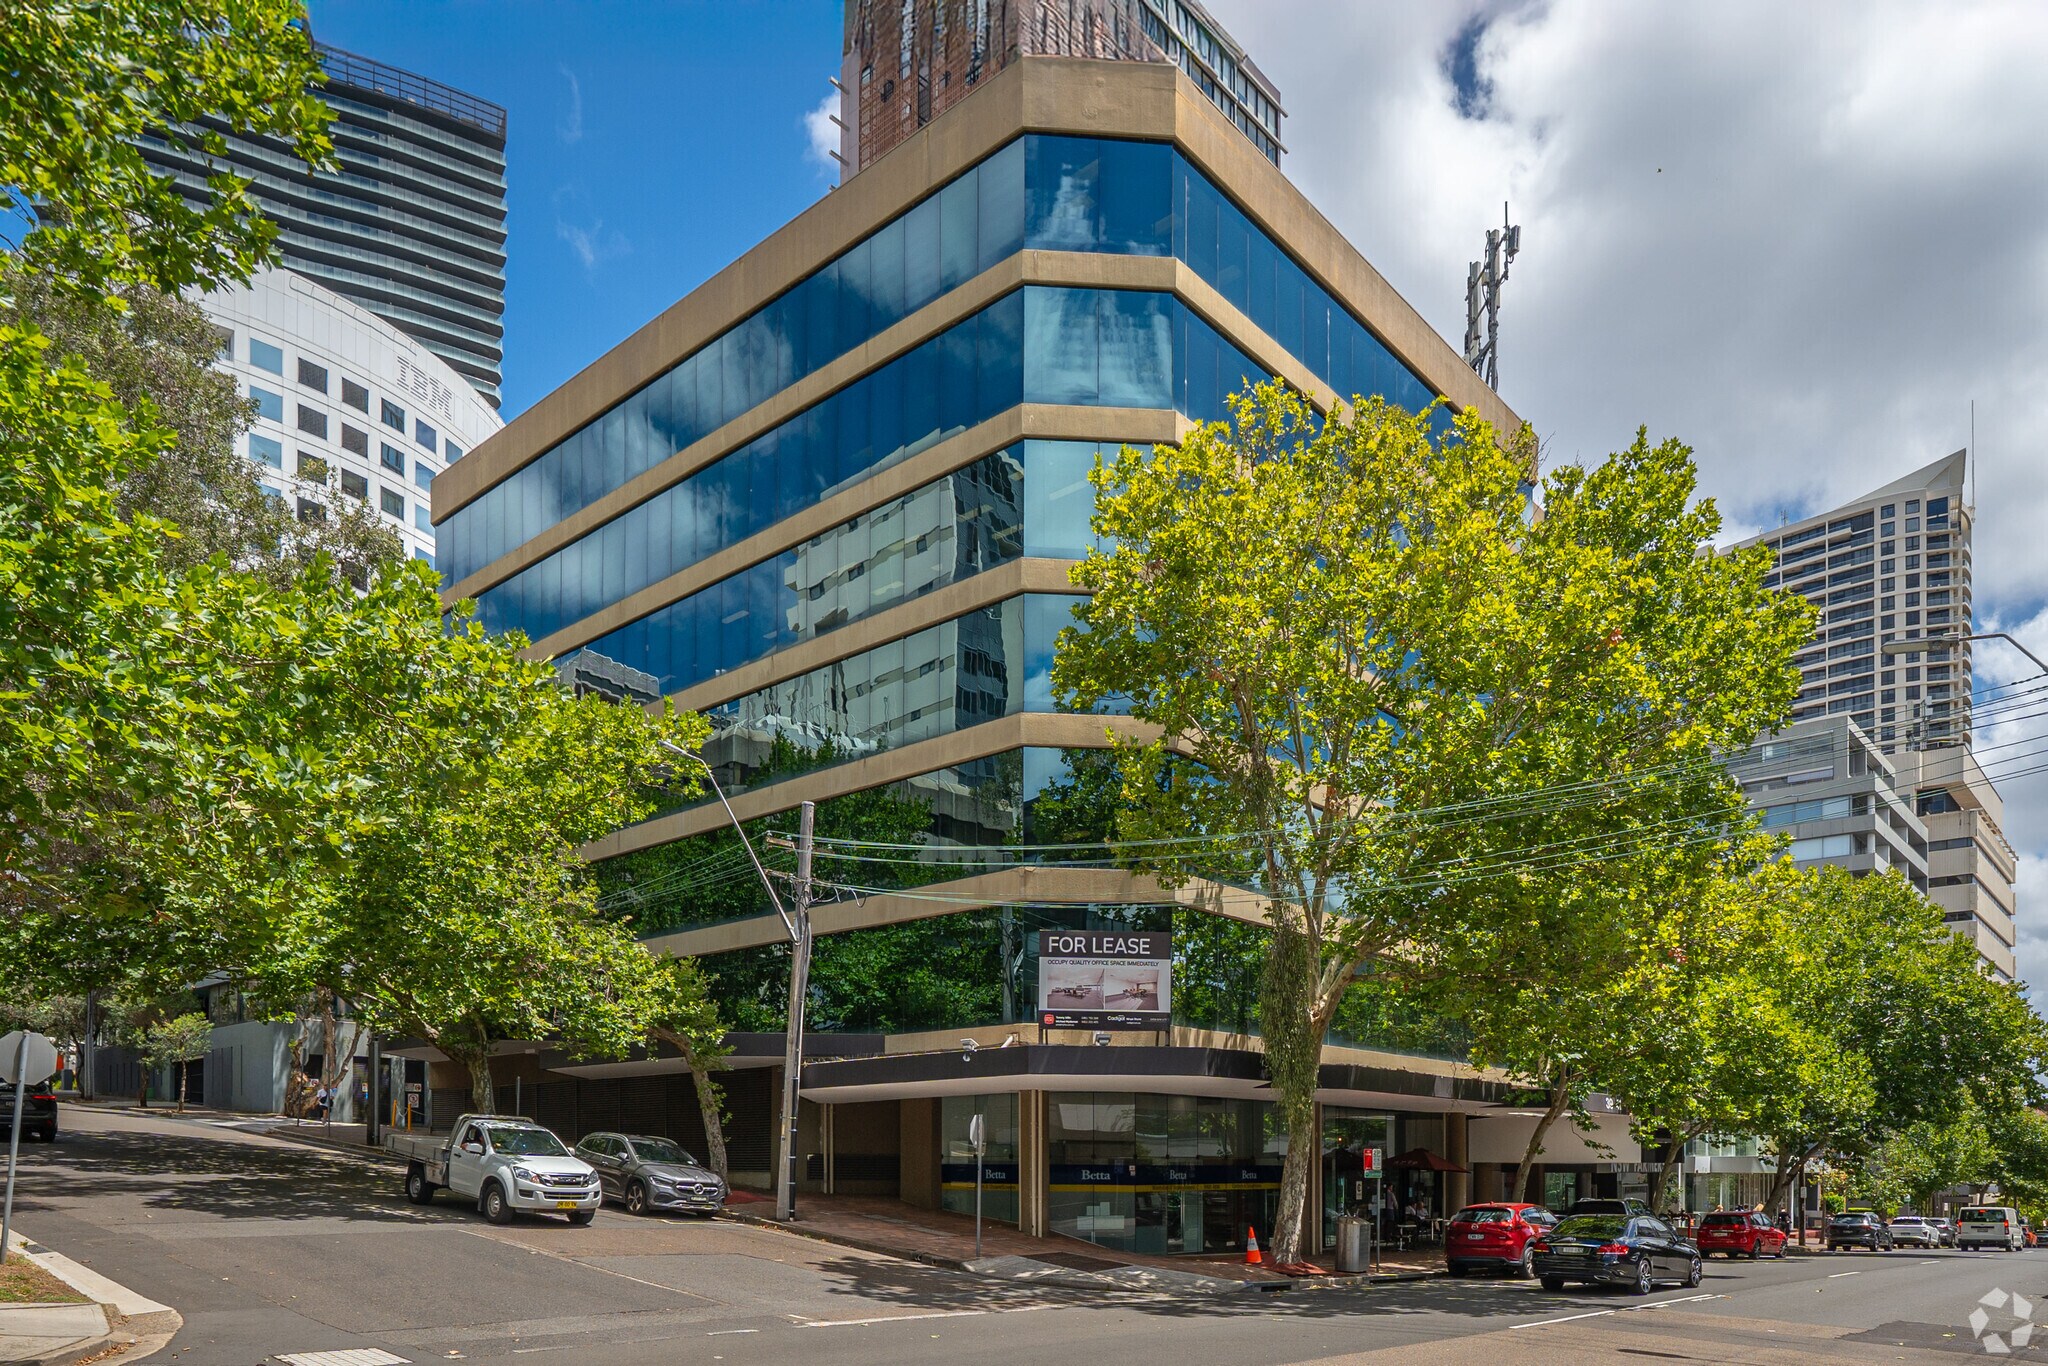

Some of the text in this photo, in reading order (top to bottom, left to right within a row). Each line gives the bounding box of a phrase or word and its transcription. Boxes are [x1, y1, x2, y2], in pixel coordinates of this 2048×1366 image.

[397, 355, 453, 421] IBM
[1048, 936, 1151, 955] FOR LEASE
[985, 1169, 1006, 1179] Betta
[1081, 1169, 1111, 1180] Betta
[1169, 1169, 1187, 1180] Betta
[1242, 1170, 1257, 1179] Betta
